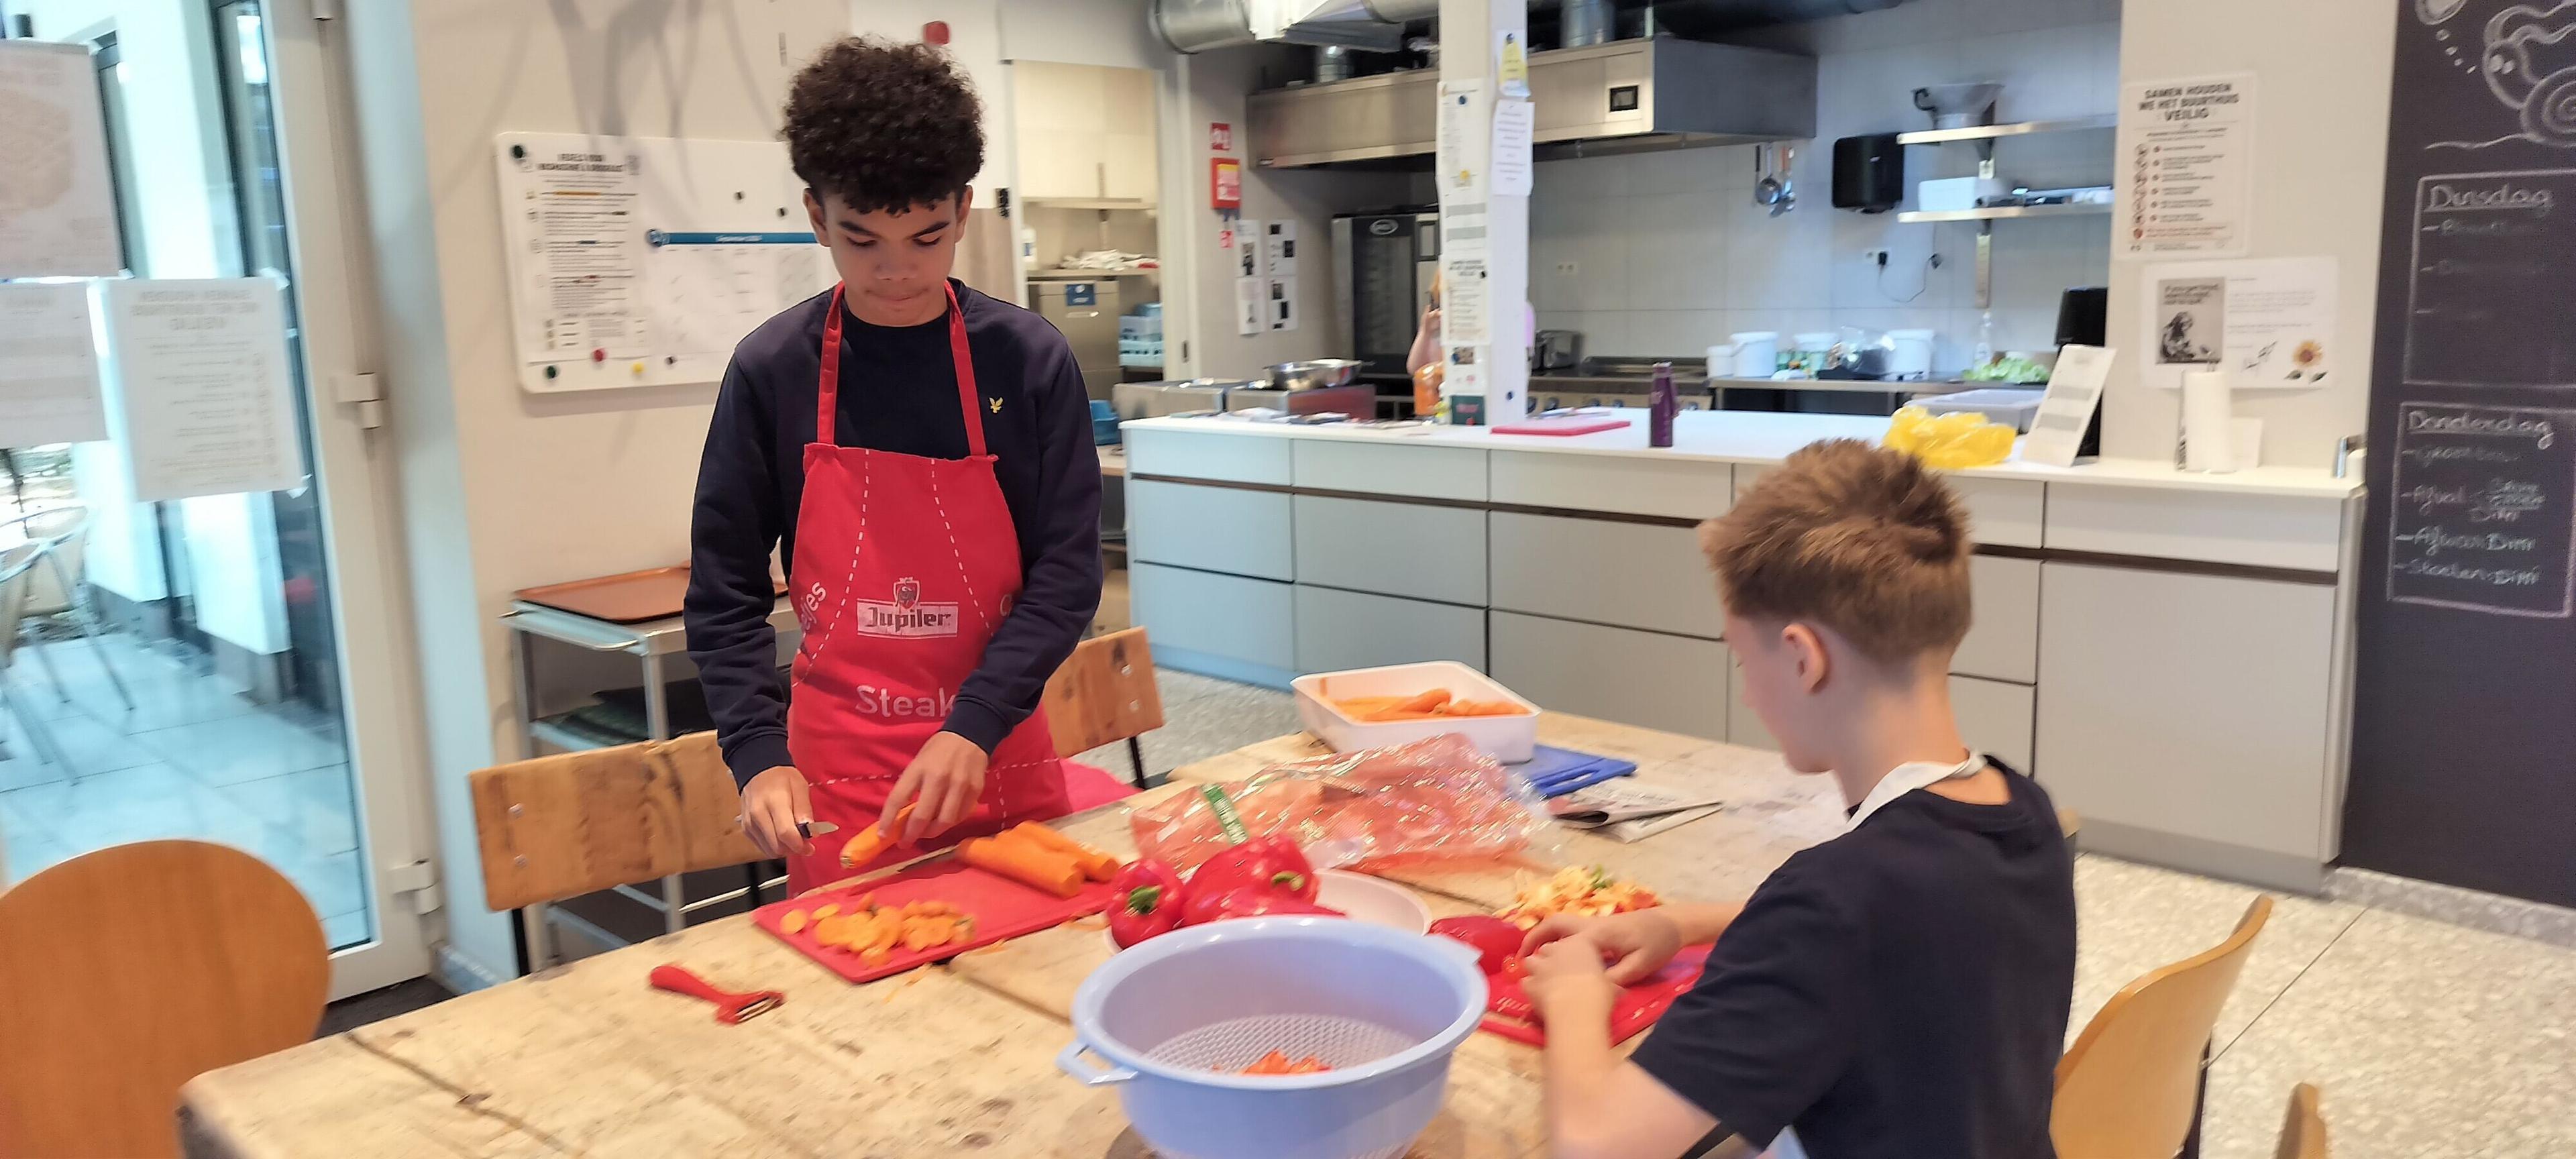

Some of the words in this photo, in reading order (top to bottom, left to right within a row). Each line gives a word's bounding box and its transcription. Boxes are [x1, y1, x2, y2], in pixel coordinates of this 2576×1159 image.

[2164, 107, 2209, 121] VEILIG
[2428, 182, 2555, 219] Dinsdag
[2409, 410, 2555, 450] Donderdag
[865, 606, 951, 632] Jupiler
